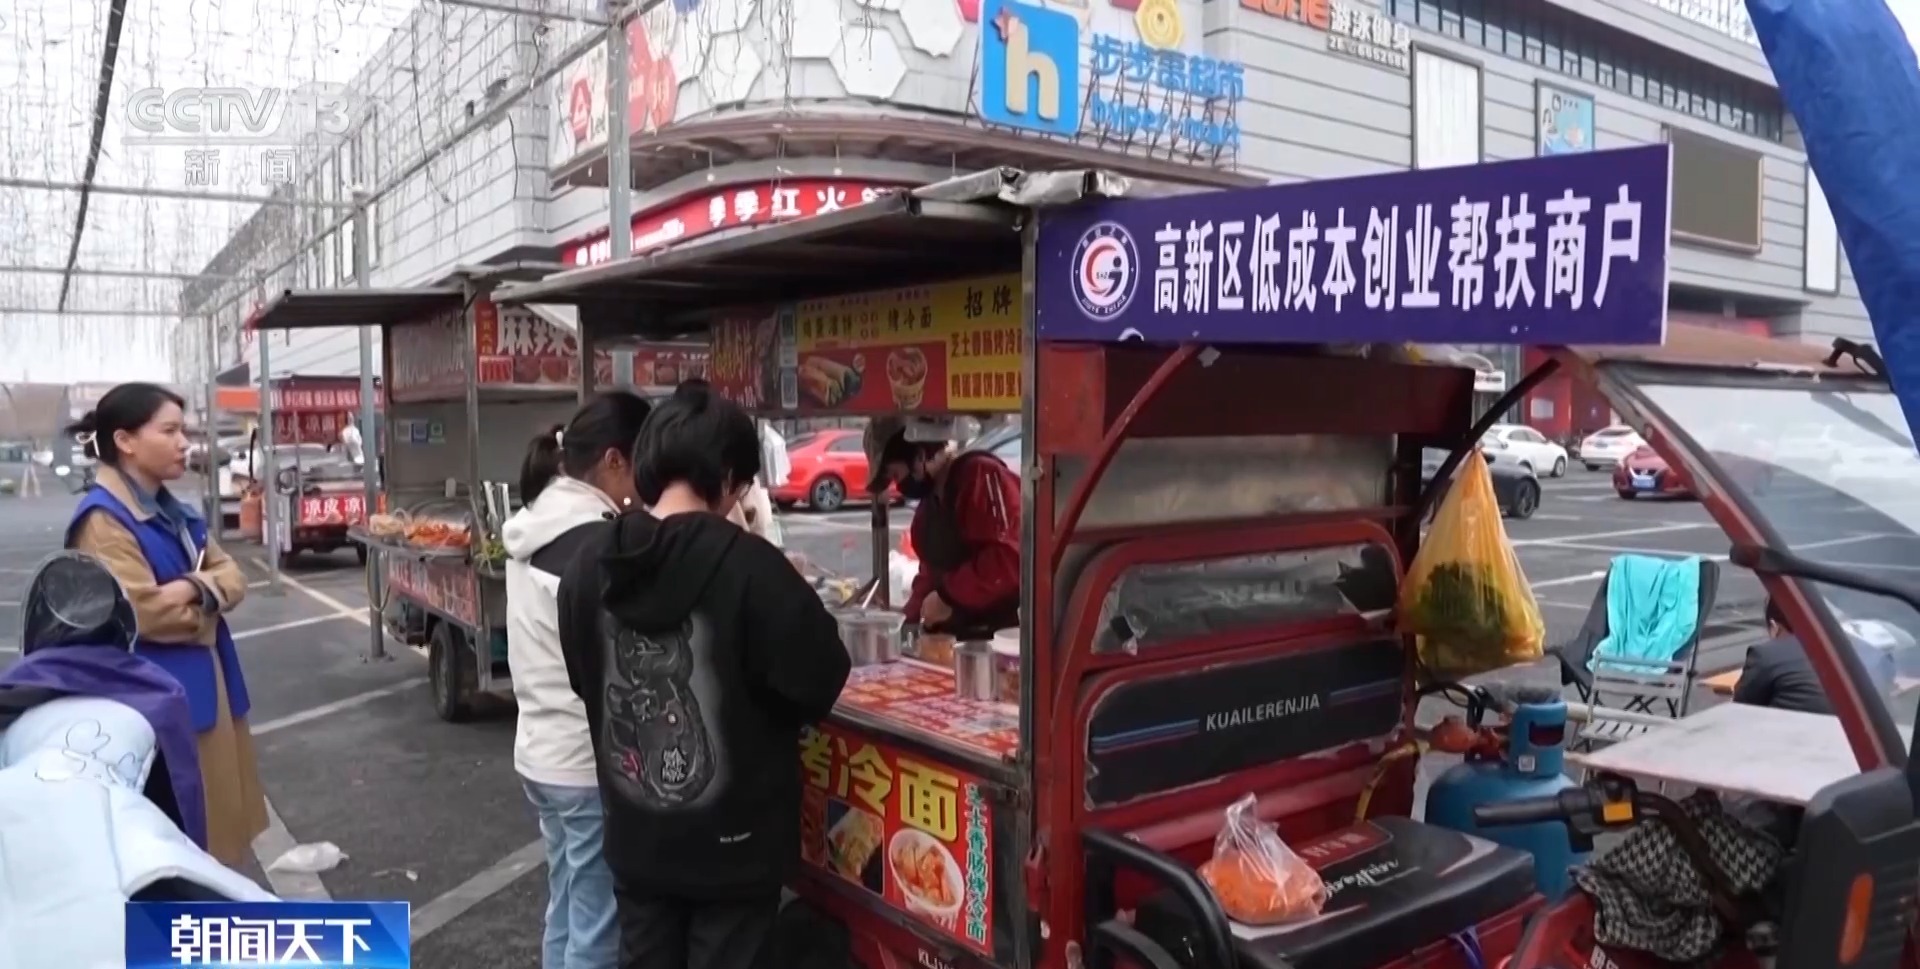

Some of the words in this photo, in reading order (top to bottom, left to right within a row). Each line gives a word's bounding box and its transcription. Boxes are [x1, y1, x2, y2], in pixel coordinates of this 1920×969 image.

[1330, 2, 1411, 52] 游泳健身
[1091, 33, 1245, 99] 步步高超市
[1153, 184, 1642, 314] 高新区低成本创业帮扶商户
[964, 284, 1012, 319] 招牌
[1206, 694, 1321, 731] KUAILERENJIA
